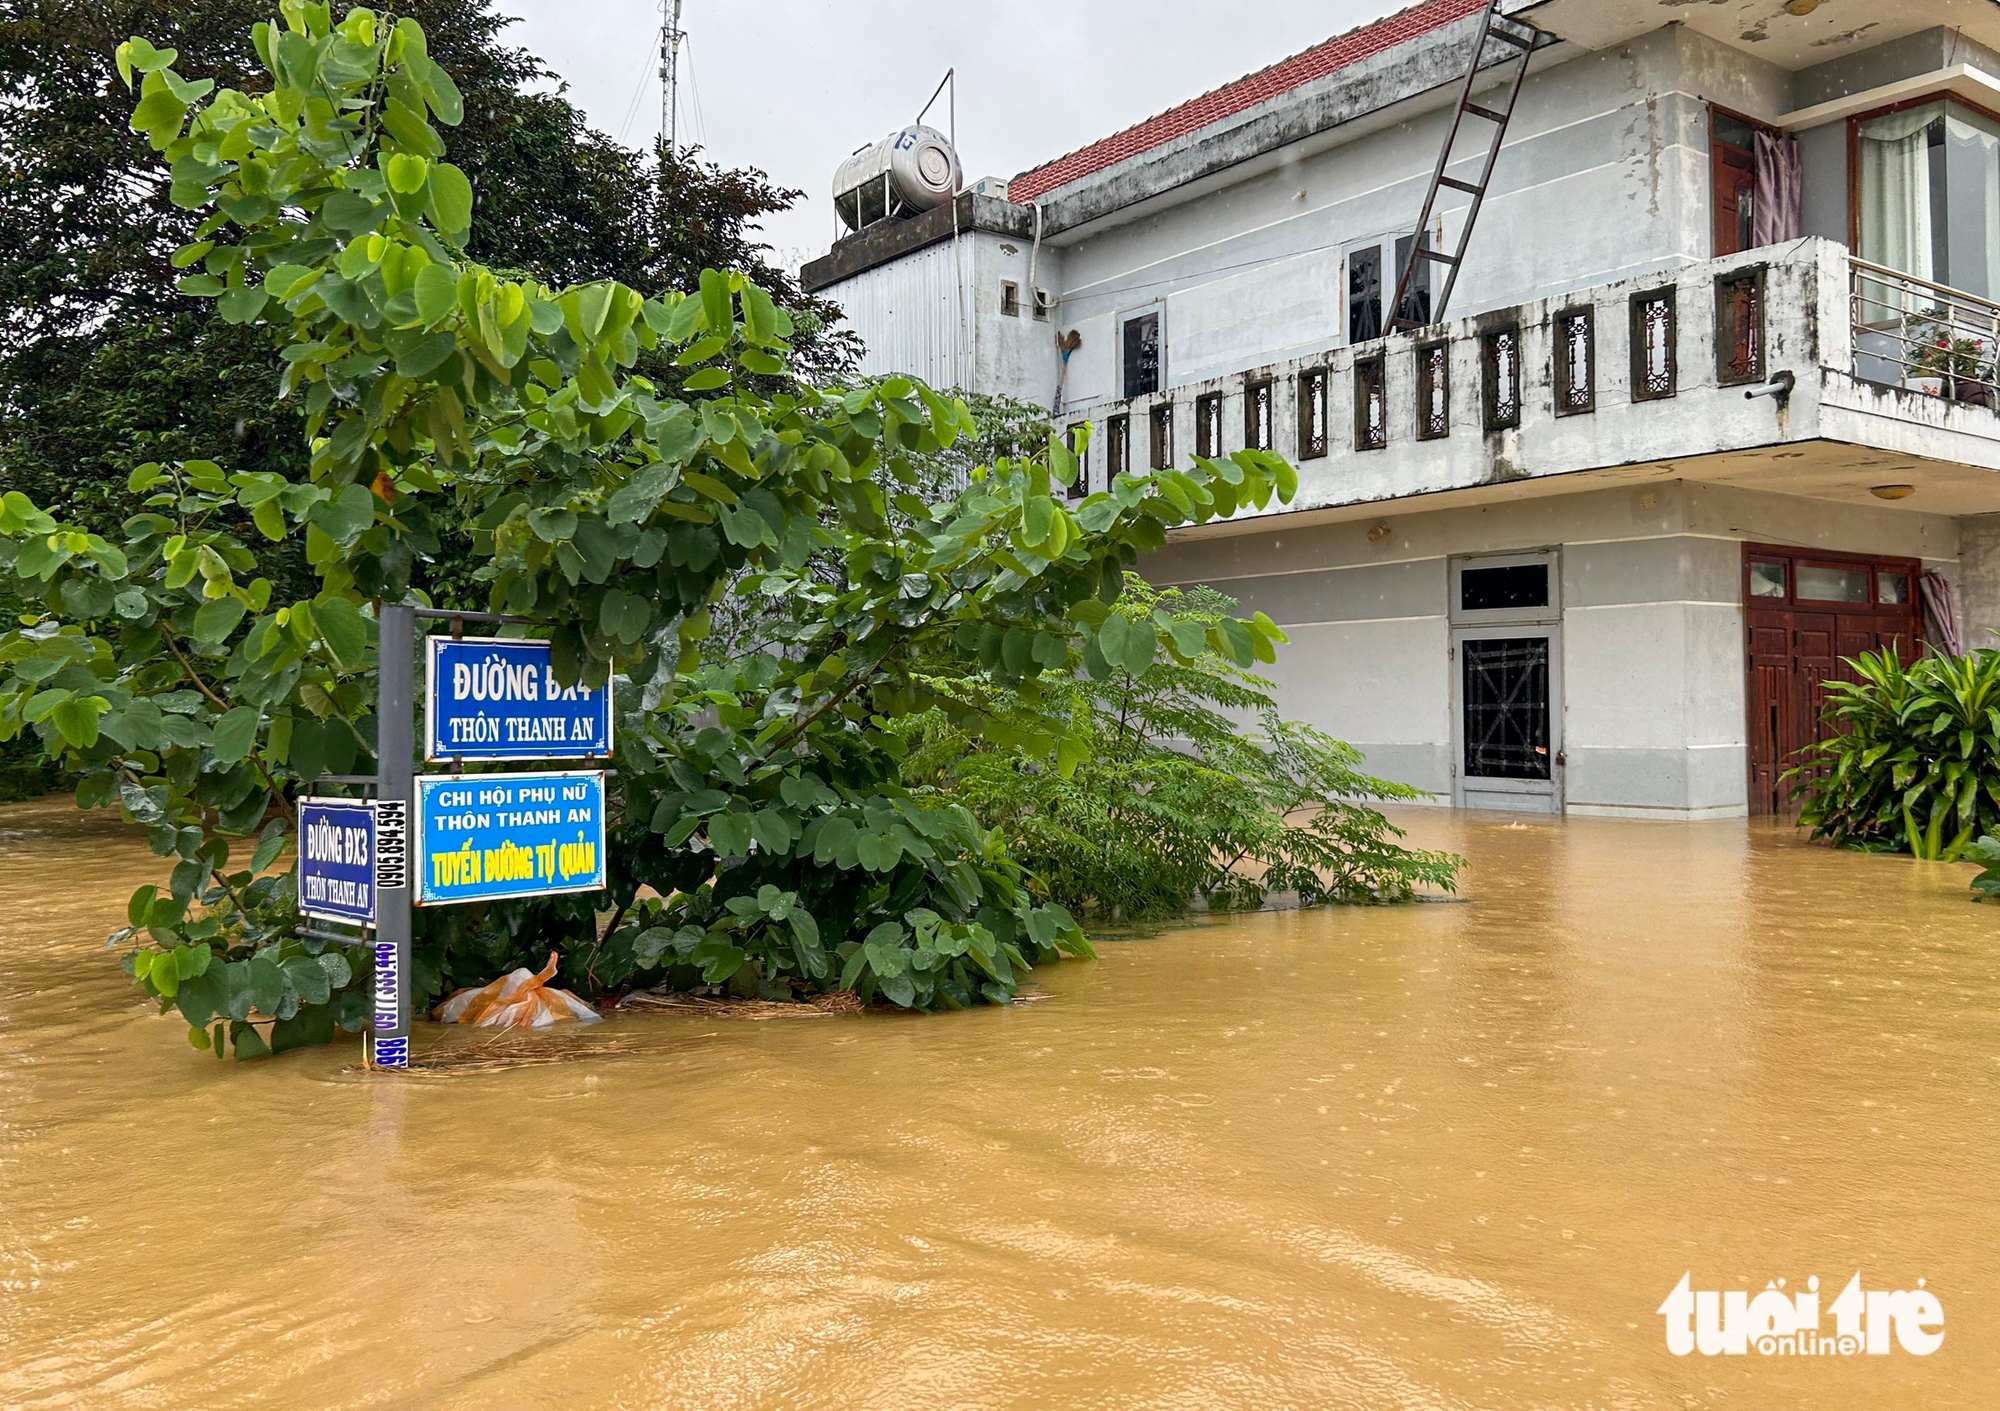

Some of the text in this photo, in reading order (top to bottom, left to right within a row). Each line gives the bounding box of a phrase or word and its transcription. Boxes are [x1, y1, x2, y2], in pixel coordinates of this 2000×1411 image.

[453, 654, 538, 701] ĐƯỜNG
[449, 710, 594, 743] THÔN THANH AN
[439, 782, 588, 808] CHI HỘI PHỤ NỮ
[434, 808, 591, 831] THÔN THANH AN
[307, 815, 368, 867] ĐƯỜNG ĐX3
[376, 801, 405, 888] 0905.894.594
[431, 830, 595, 887] TUYẾN ĐƯỜNG TỰ QUẢN
[306, 872, 369, 909] THÔN THANH AN
